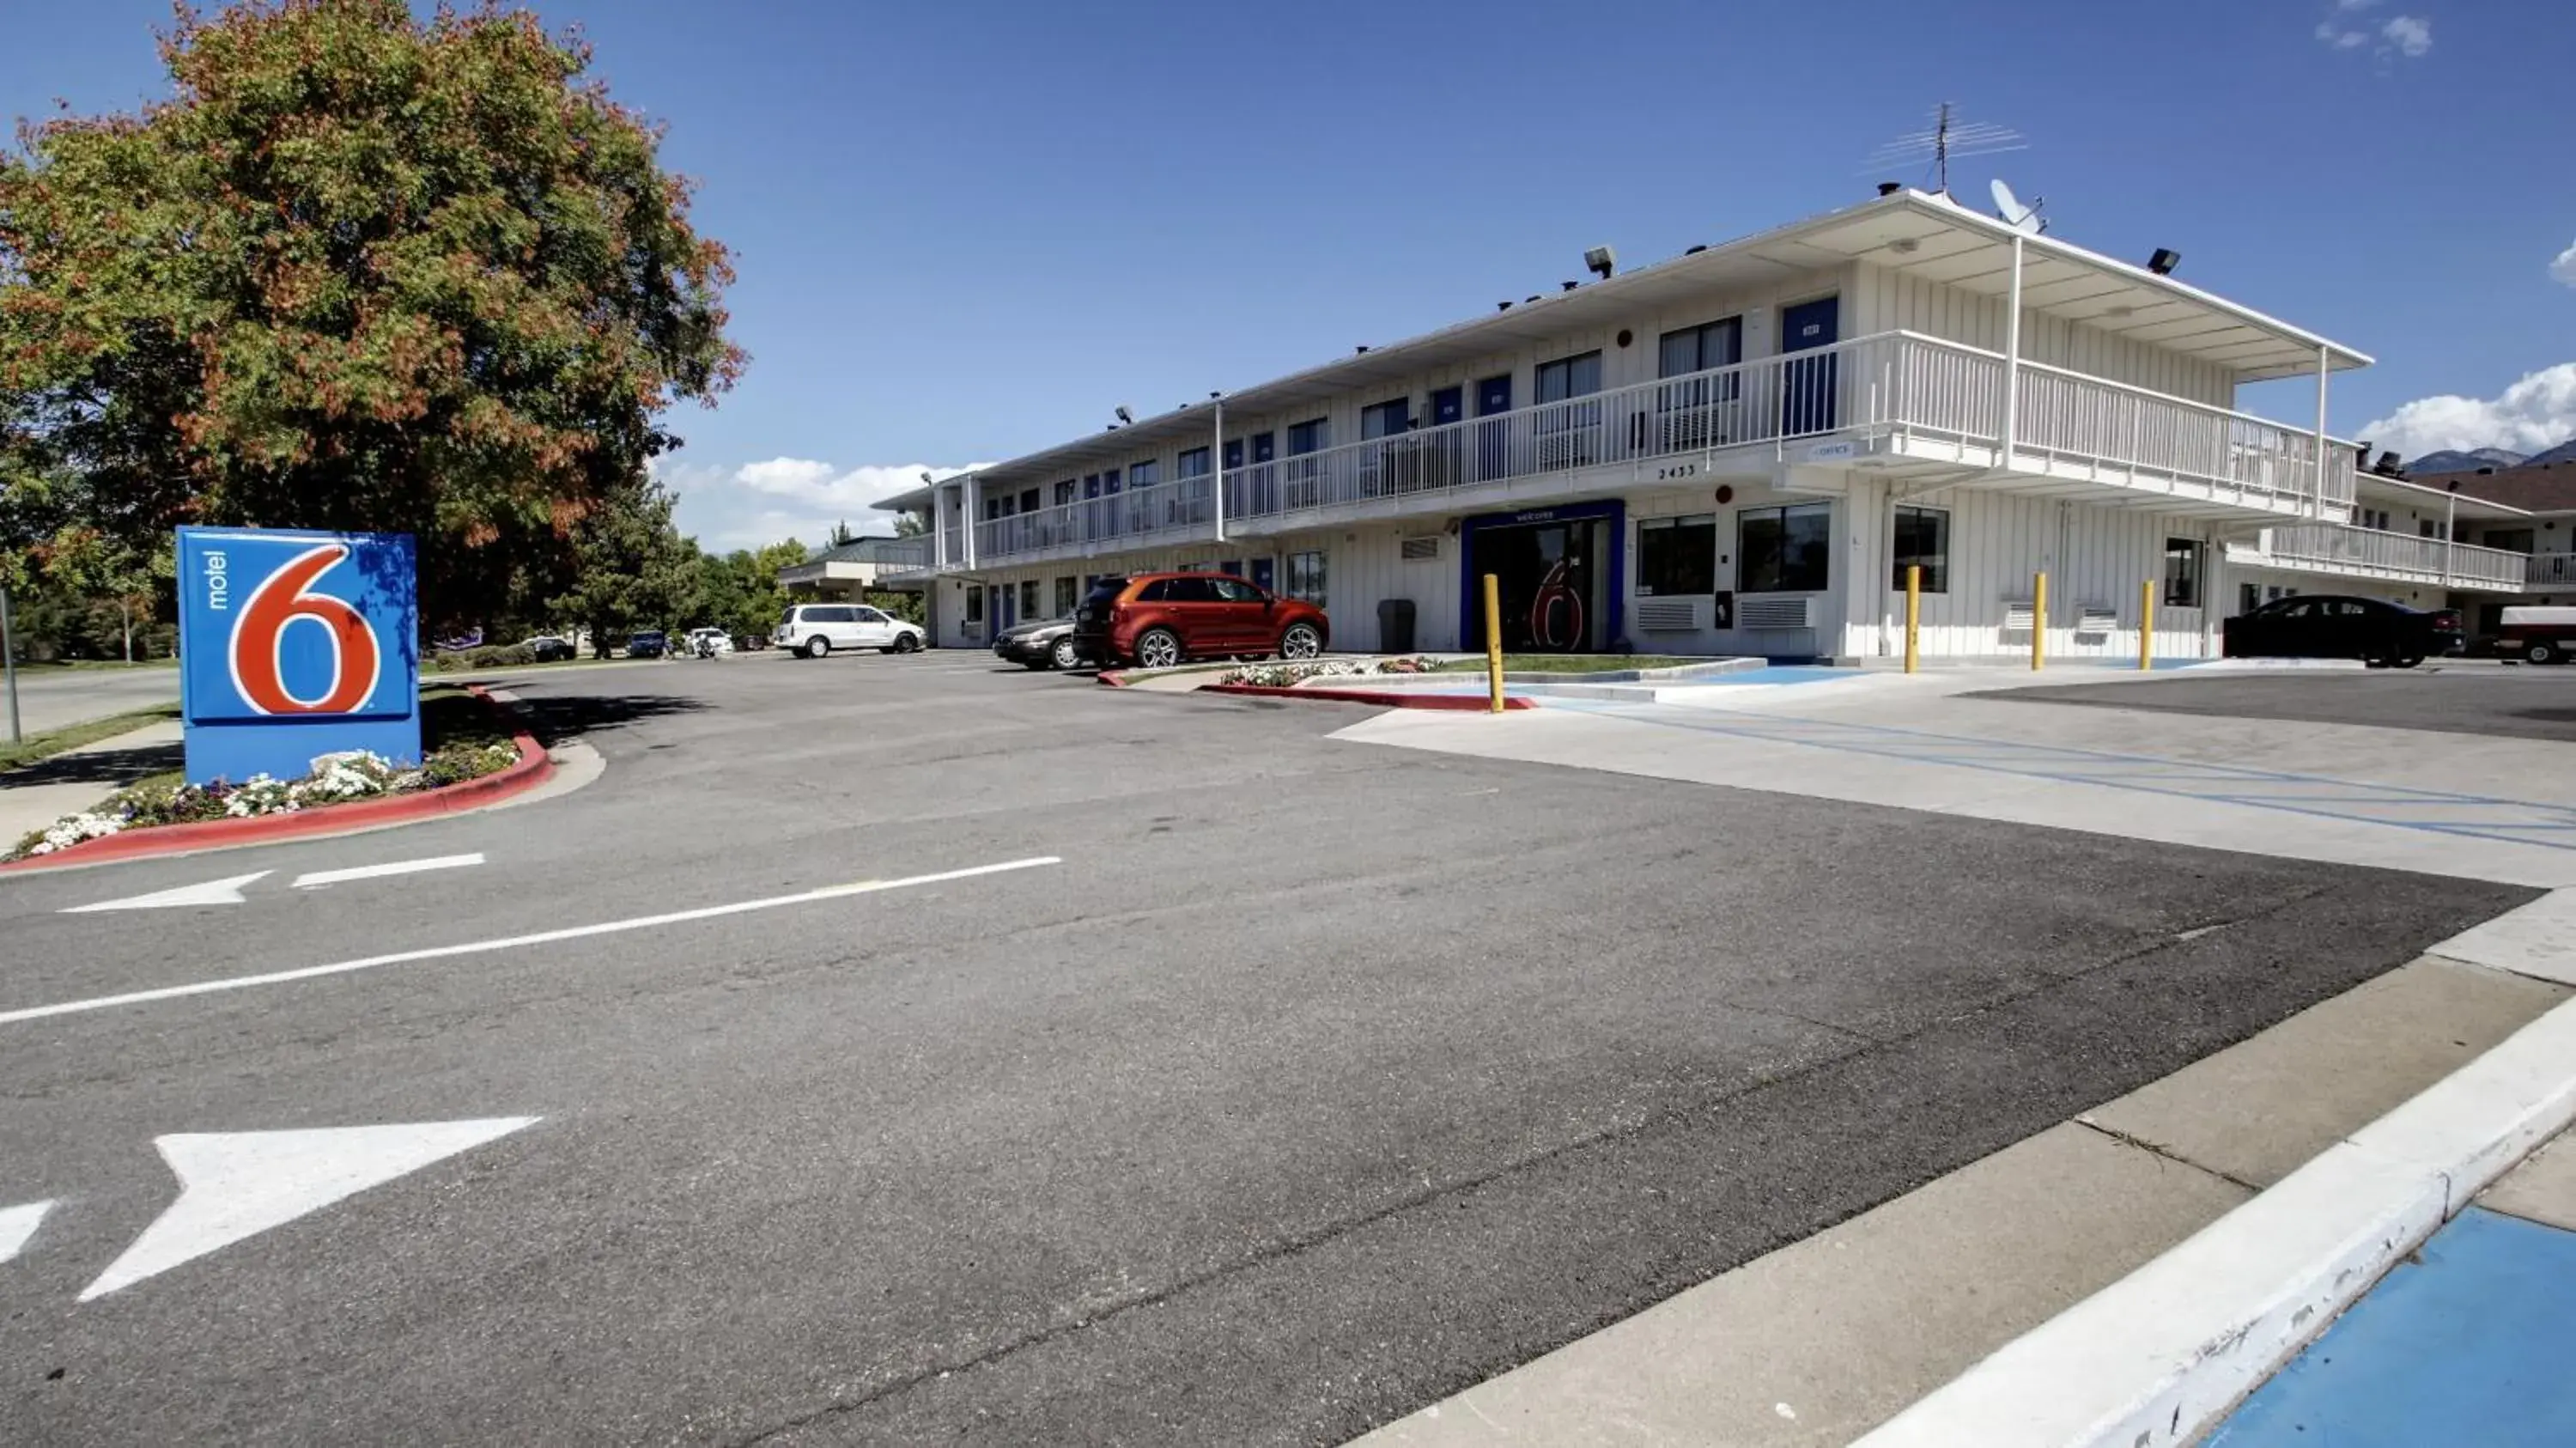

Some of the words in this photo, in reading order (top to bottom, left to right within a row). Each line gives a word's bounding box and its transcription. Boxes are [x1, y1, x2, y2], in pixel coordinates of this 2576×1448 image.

[1658, 464, 1695, 480] 2433
[202, 550, 228, 610] motel
[228, 543, 381, 716] 6
[1531, 560, 1583, 652] 6
